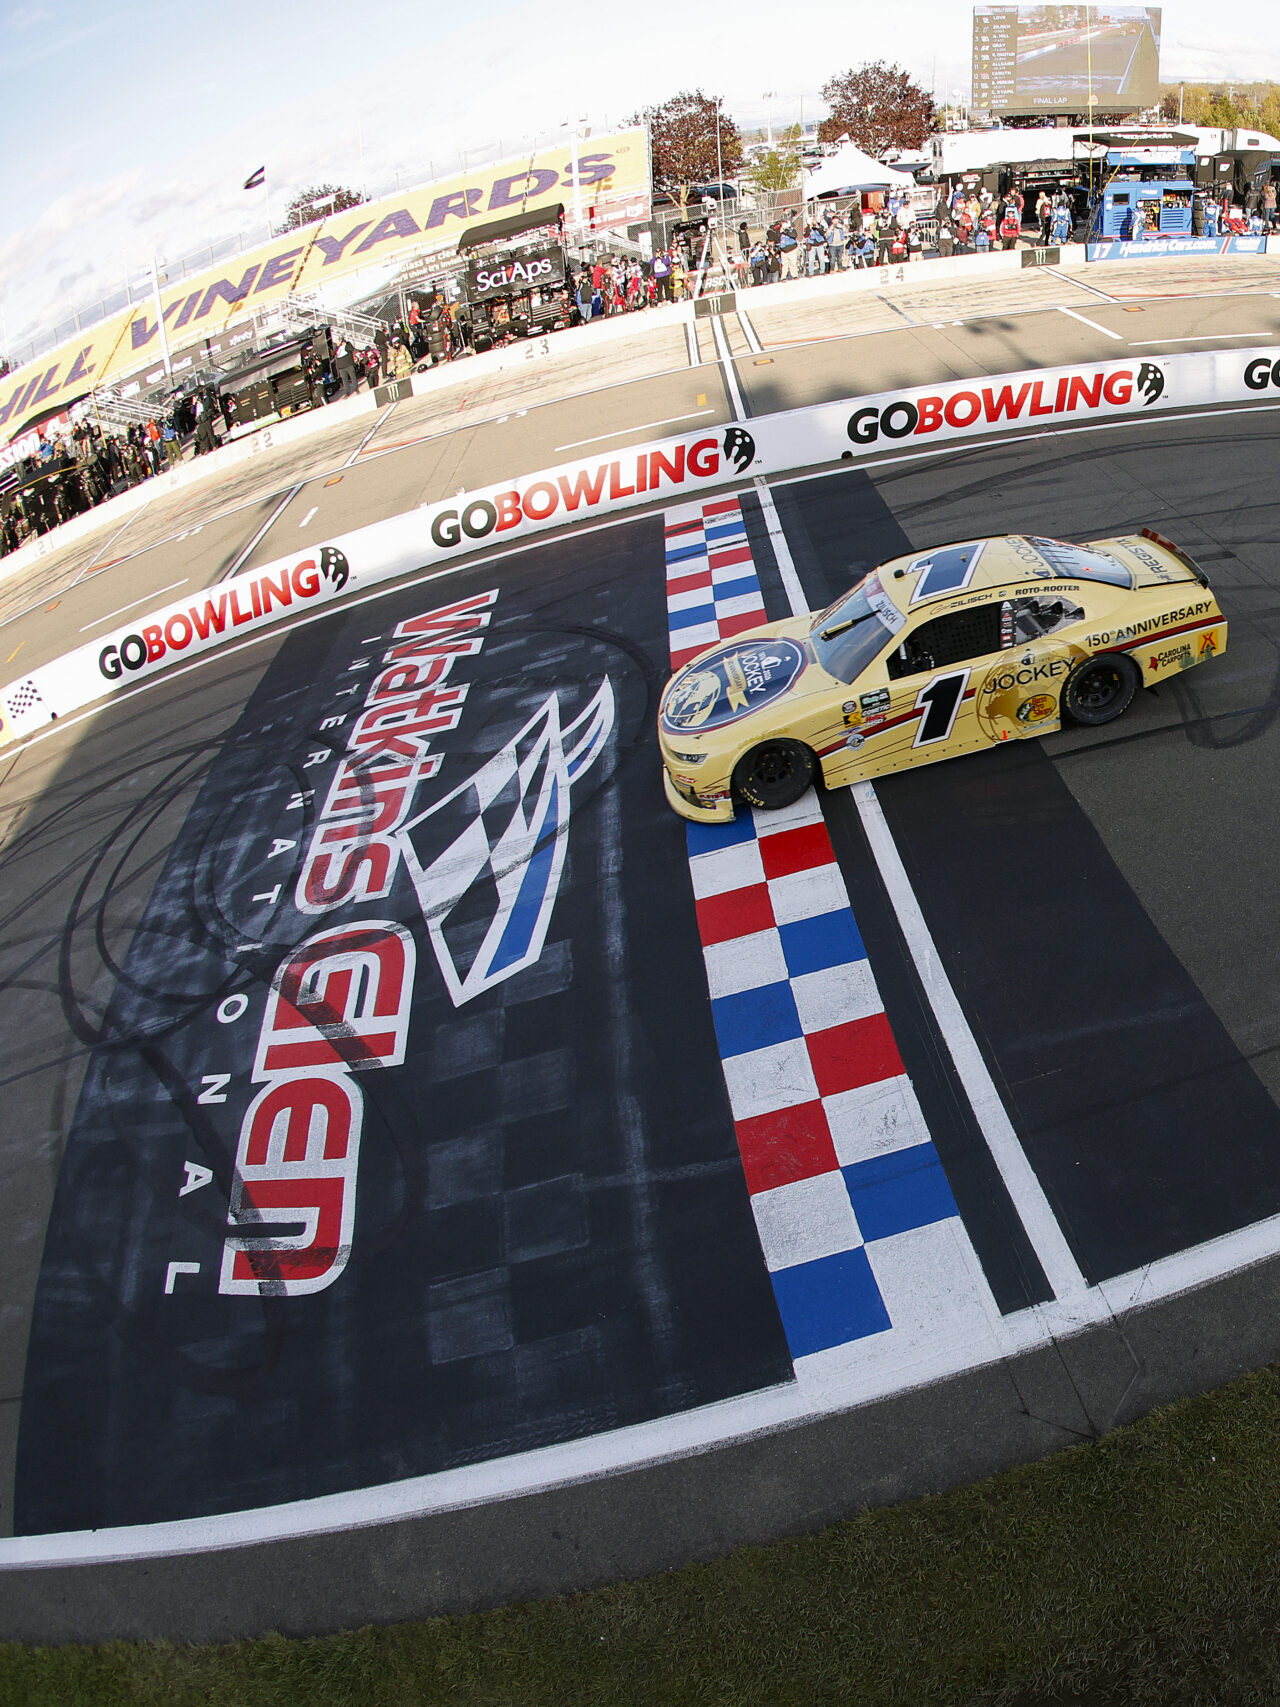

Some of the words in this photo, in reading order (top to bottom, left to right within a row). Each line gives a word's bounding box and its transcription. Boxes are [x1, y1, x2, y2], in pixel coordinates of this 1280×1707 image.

[131, 153, 616, 350] VINEYARDS
[1093, 244, 1113, 259] 17
[476, 257, 552, 293] SciAps
[880, 266, 904, 284] 24
[228, 330, 253, 346] xfinity
[525, 338, 550, 359] 23
[848, 370, 1132, 444] GOBOWLING
[432, 436, 720, 549] GOBOWLING
[876, 599, 899, 625] ZILISCH
[950, 593, 993, 610] ZILISCH
[1015, 584, 1080, 596] ROTO-ROOTER
[98, 560, 320, 680] GOBOWLING
[1116, 600, 1212, 641] ANNIVERSARY
[1158, 643, 1191, 660] CAROLINA
[741, 650, 766, 694] JOCKEY
[983, 657, 1076, 695] JOCKEY
[911, 667, 971, 749] 1
[296, 588, 499, 915] Watkins
[165, 634, 377, 1296] INTERNATIONAL
